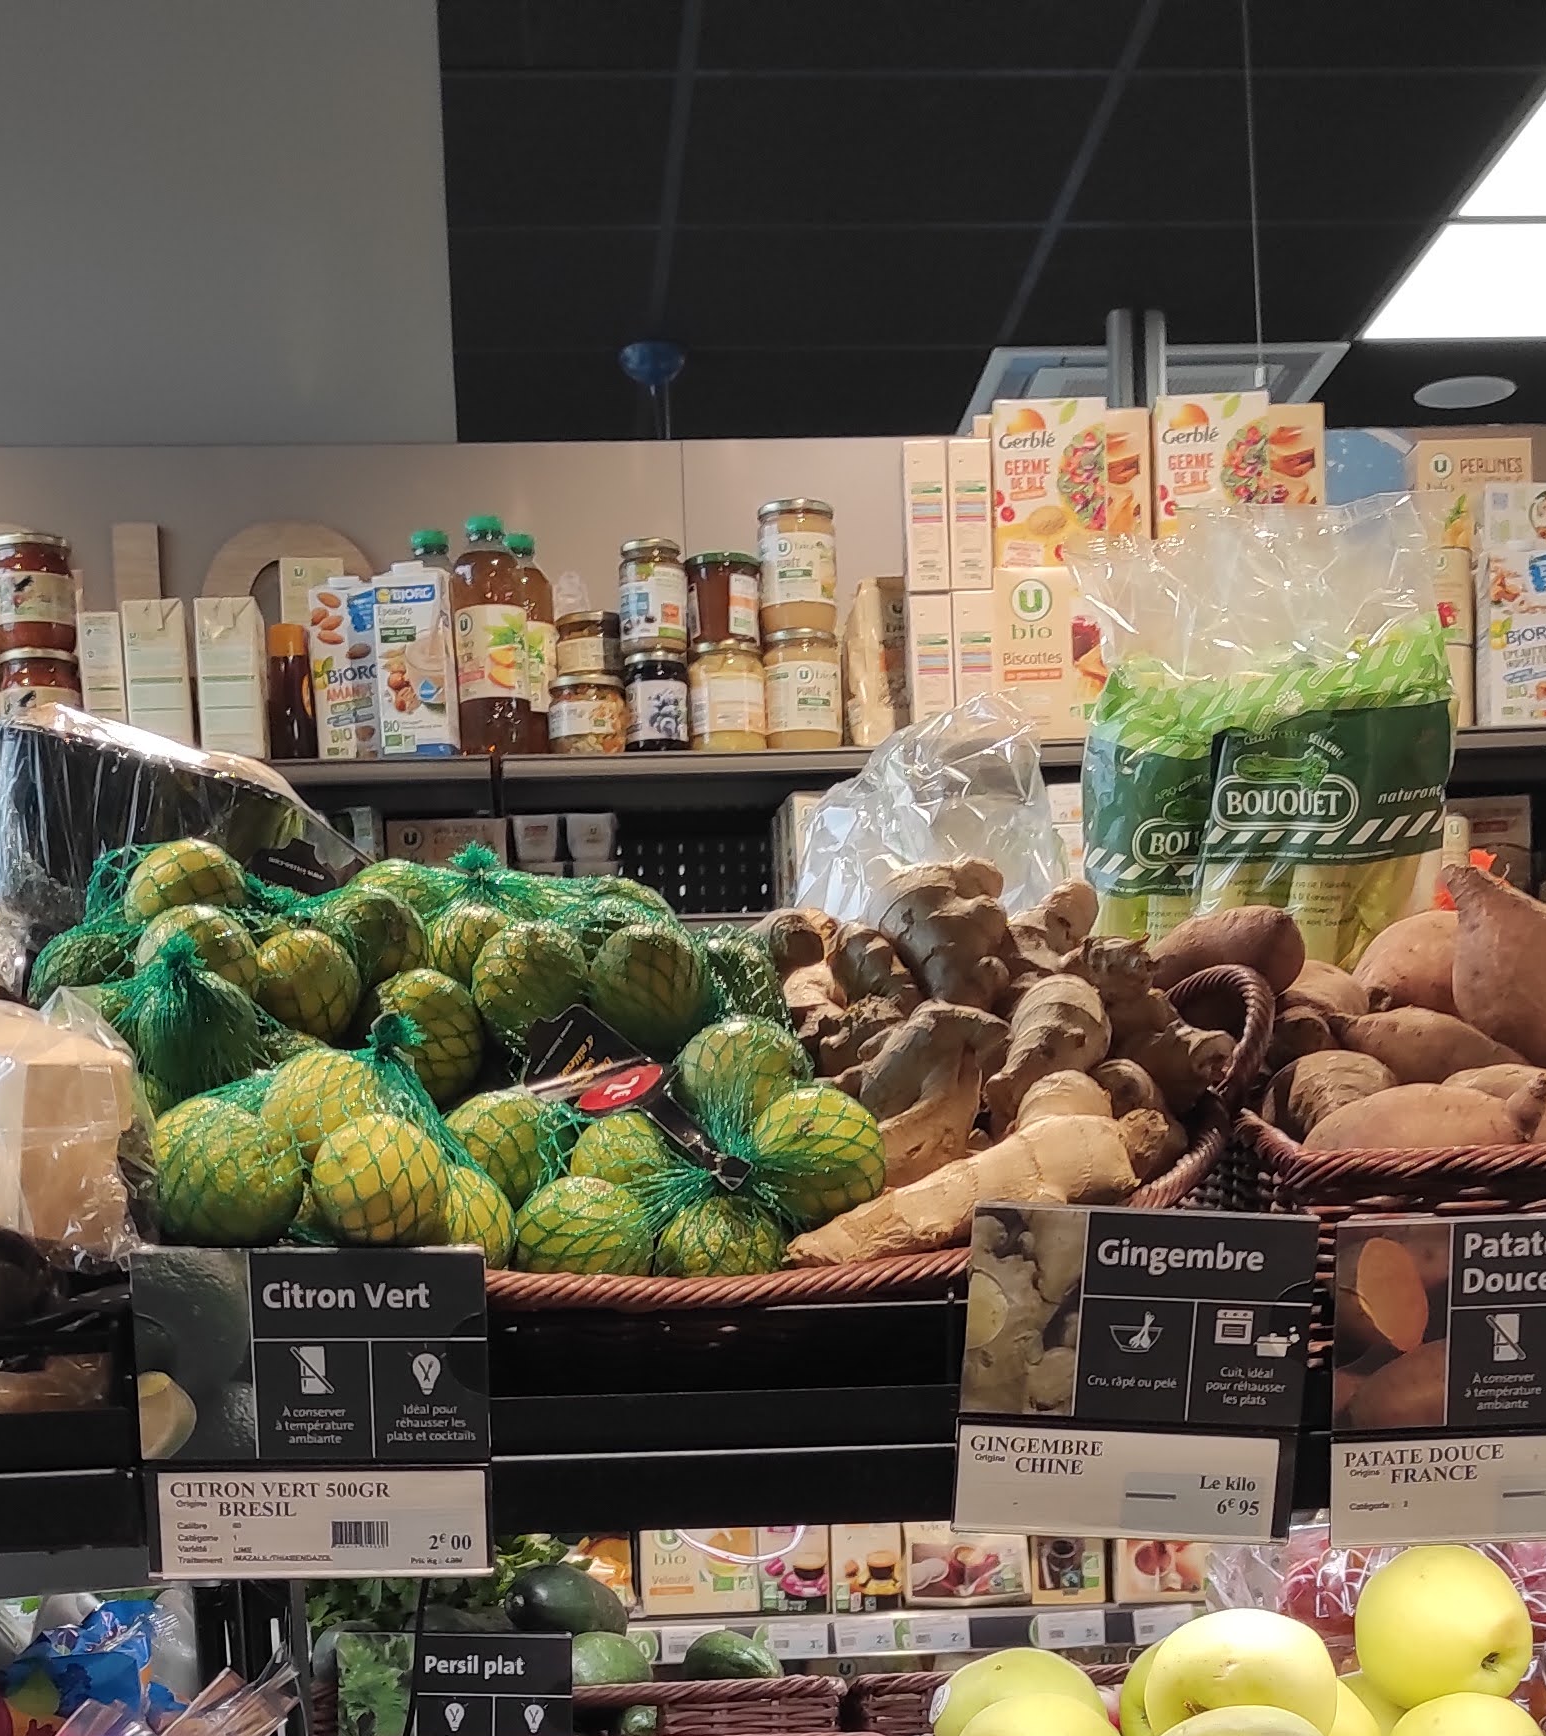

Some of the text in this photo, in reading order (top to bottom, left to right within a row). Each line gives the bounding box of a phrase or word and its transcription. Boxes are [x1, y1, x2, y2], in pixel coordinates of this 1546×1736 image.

[998, 432, 1055, 450] Gerblé
[1162, 425, 1220, 446] Gerblé
[1004, 457, 1051, 476] GERME
[1168, 453, 1214, 470] GERME
[1010, 623, 1053, 640] bio
[1002, 650, 1063, 666] Biscottes
[1226, 788, 1343, 817] BOUQUET
[1096, 1237, 1266, 1277] Gingembre
[262, 1280, 432, 1309] Citron Vert
[1137, 1377, 1152, 1389] ou
[1482, 1372, 1536, 1385] conserver
[1205, 1381, 1232, 1394] pour
[1474, 1384, 1542, 1398] température
[1222, 1392, 1267, 1407] les plats
[1476, 1398, 1530, 1411] ambiante
[292, 1408, 347, 1418] conserver
[403, 1404, 458, 1419] Idéal pour
[285, 1419, 355, 1434] température
[451, 1416, 467, 1429] les
[288, 1433, 343, 1445] ambiante
[386, 1431, 477, 1445] plats et cocktails
[969, 1434, 1104, 1458] GINGEMBRE
[1344, 1443, 1504, 1468] PATATE DOUCE
[1014, 1456, 1085, 1476] CHINE
[1390, 1464, 1479, 1485] FRANCE
[169, 1481, 391, 1499] CITRON VERT 500GR
[1199, 1474, 1257, 1492] Le kilo
[218, 1501, 298, 1518] BRESIL
[653, 1553, 687, 1566] bio
[424, 1654, 526, 1680] Persil plat
